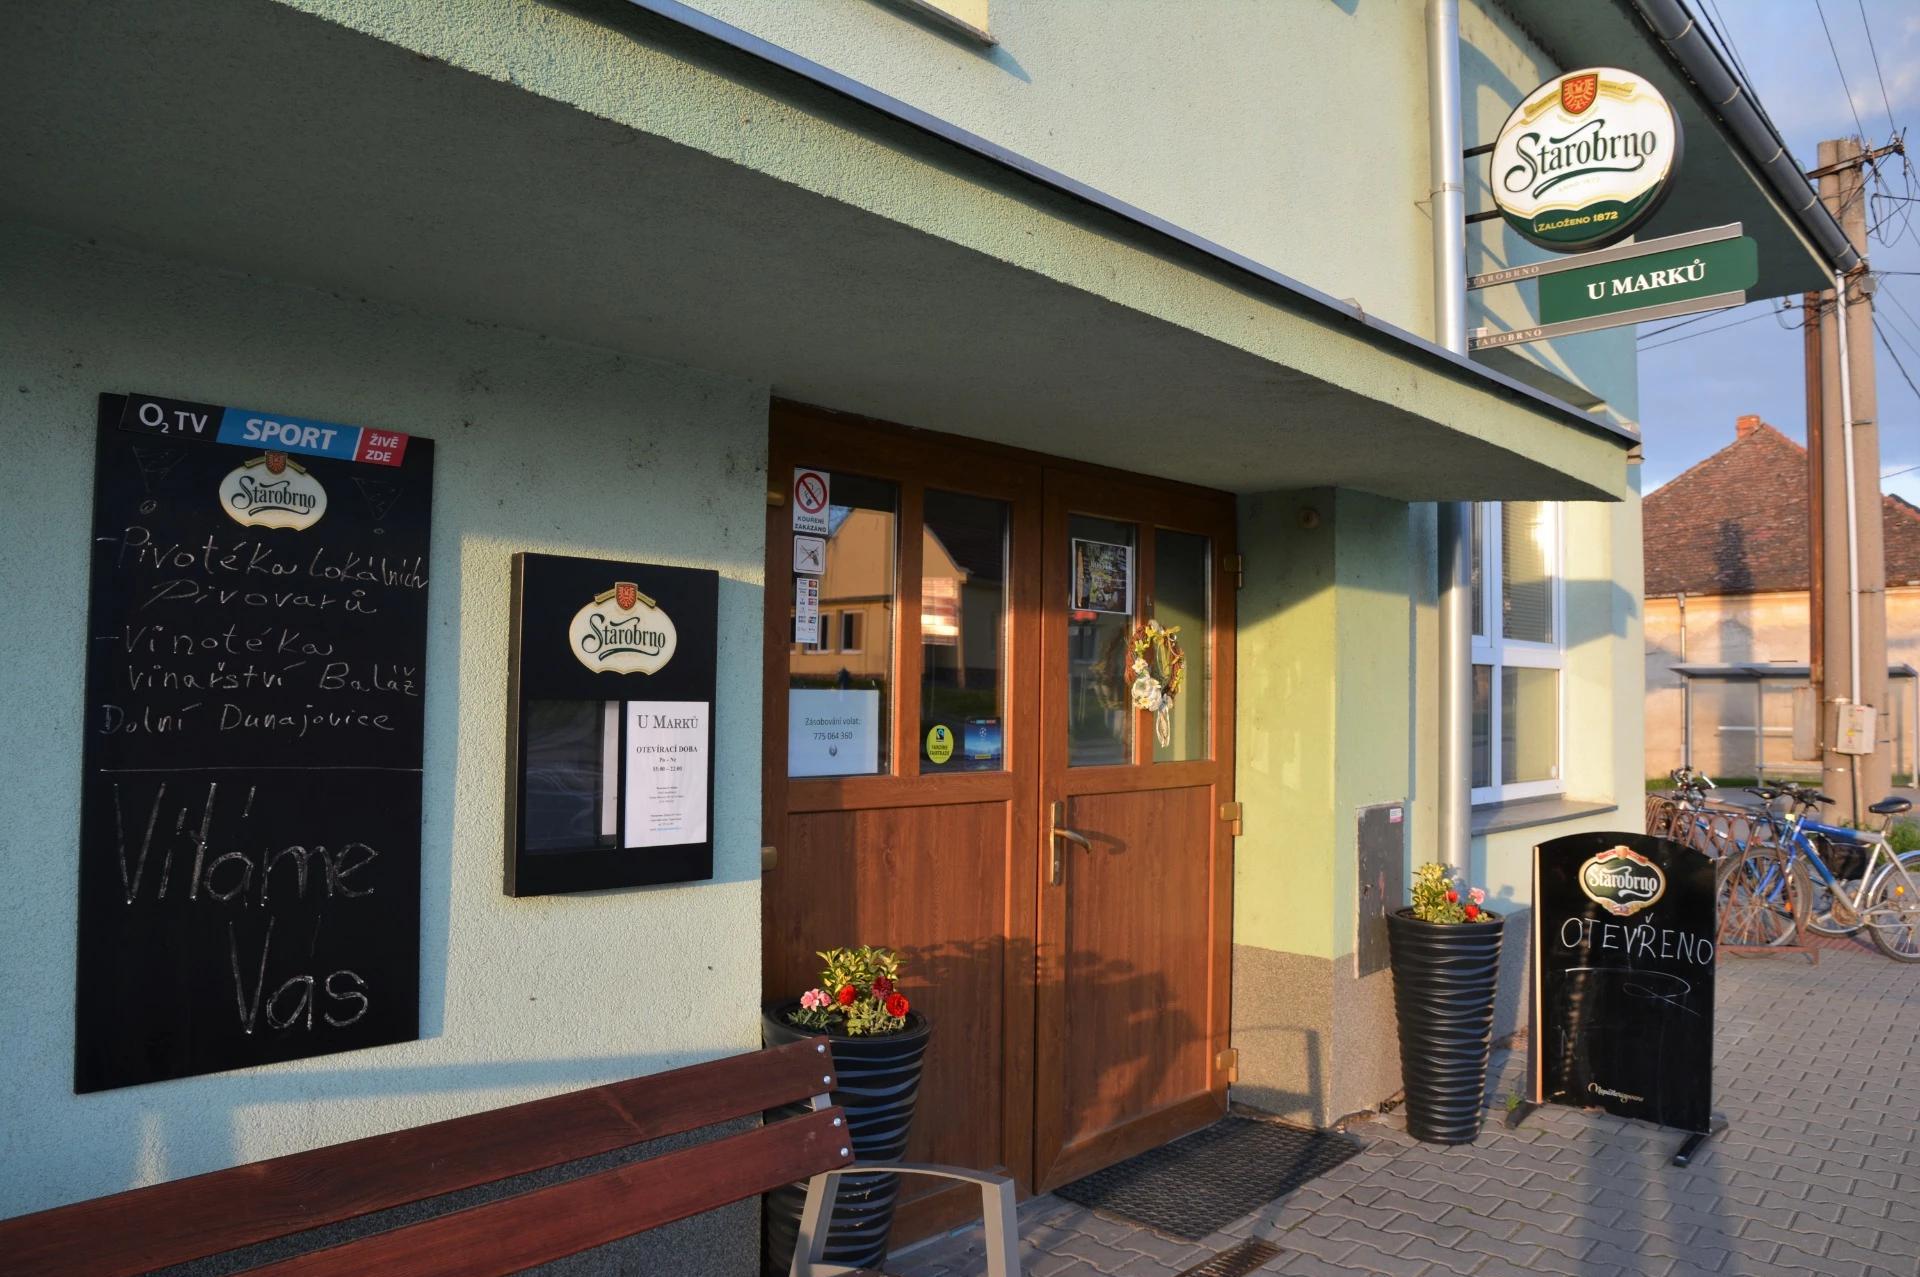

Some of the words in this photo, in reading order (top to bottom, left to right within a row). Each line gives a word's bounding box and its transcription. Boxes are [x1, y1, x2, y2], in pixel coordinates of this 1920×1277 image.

[1504, 118, 1656, 199] Starobrno
[1538, 216, 1591, 232] ZALOŽENO
[1593, 211, 1619, 224] 1872
[1587, 281, 1606, 300] U
[1611, 258, 1706, 296] MARKŮ
[174, 411, 208, 433] TV
[242, 418, 338, 450] SPORT
[368, 432, 399, 449] ŽIVĚ
[366, 450, 391, 462] ZDE
[231, 475, 316, 516] Starobrno
[581, 613, 666, 661] Starobrno
[98, 703, 203, 733] Dolní
[220, 703, 394, 737] Dunajovice
[637, 715, 649, 729] U
[804, 716, 842, 726] Zásobování
[636, 744, 677, 753] OTEVÍRACÍ
[678, 745, 698, 753] DOBA
[1588, 865, 1658, 897] Starobrno
[1561, 912, 1714, 965] OTEVŘENO
